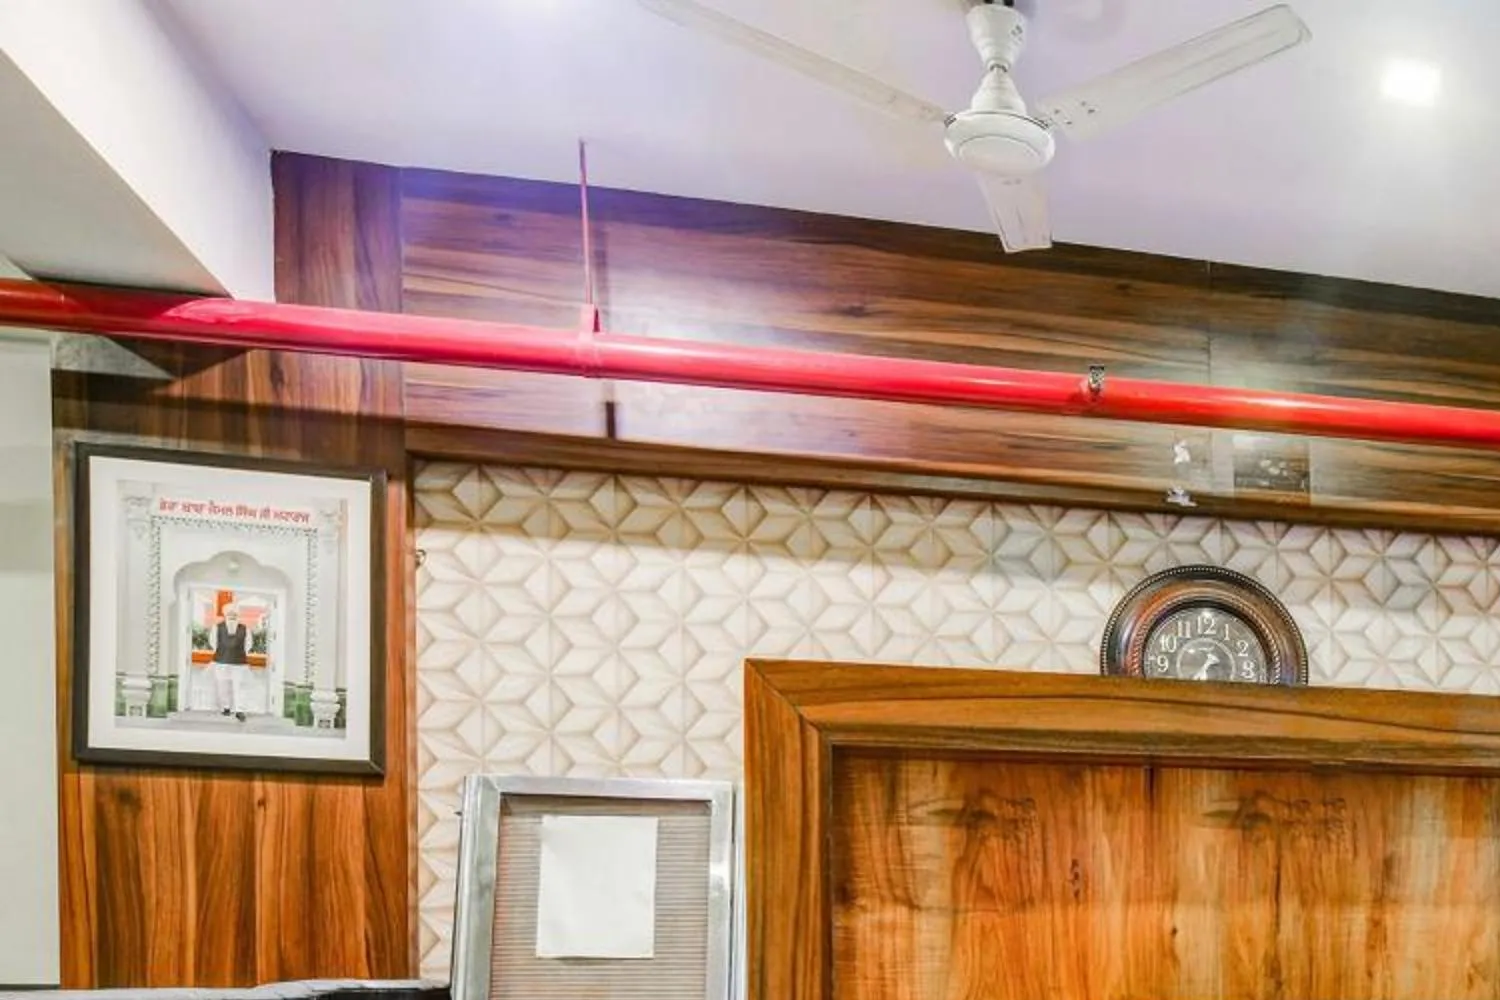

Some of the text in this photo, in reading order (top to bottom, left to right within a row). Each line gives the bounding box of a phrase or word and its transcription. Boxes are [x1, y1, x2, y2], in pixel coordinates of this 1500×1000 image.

[1177, 621, 1192, 639] 11
[1197, 615, 1217, 635] 12
[1223, 623, 1231, 641] 1
[1161, 634, 1177, 653] 10
[1237, 640, 1249, 657] 2
[1157, 654, 1169, 673] 9
